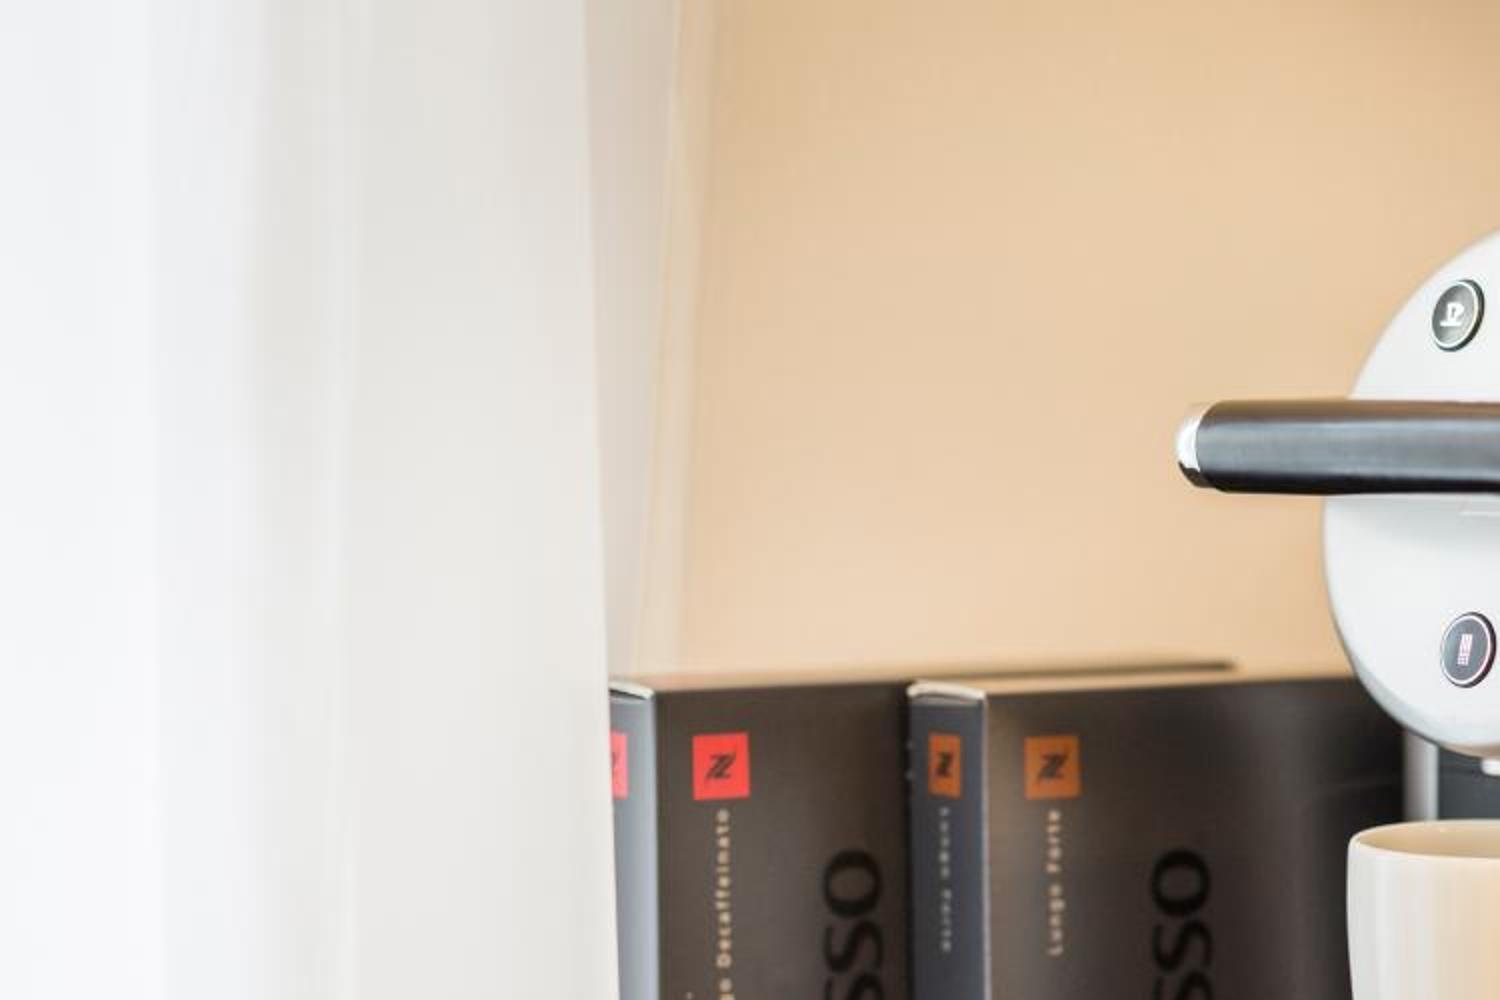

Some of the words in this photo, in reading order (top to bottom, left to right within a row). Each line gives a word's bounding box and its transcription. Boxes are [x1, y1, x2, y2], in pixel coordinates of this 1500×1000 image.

[1045, 809, 1062, 874] Forte
[715, 807, 732, 969] Decaffeinato
[1047, 883, 1066, 957] Lungo
